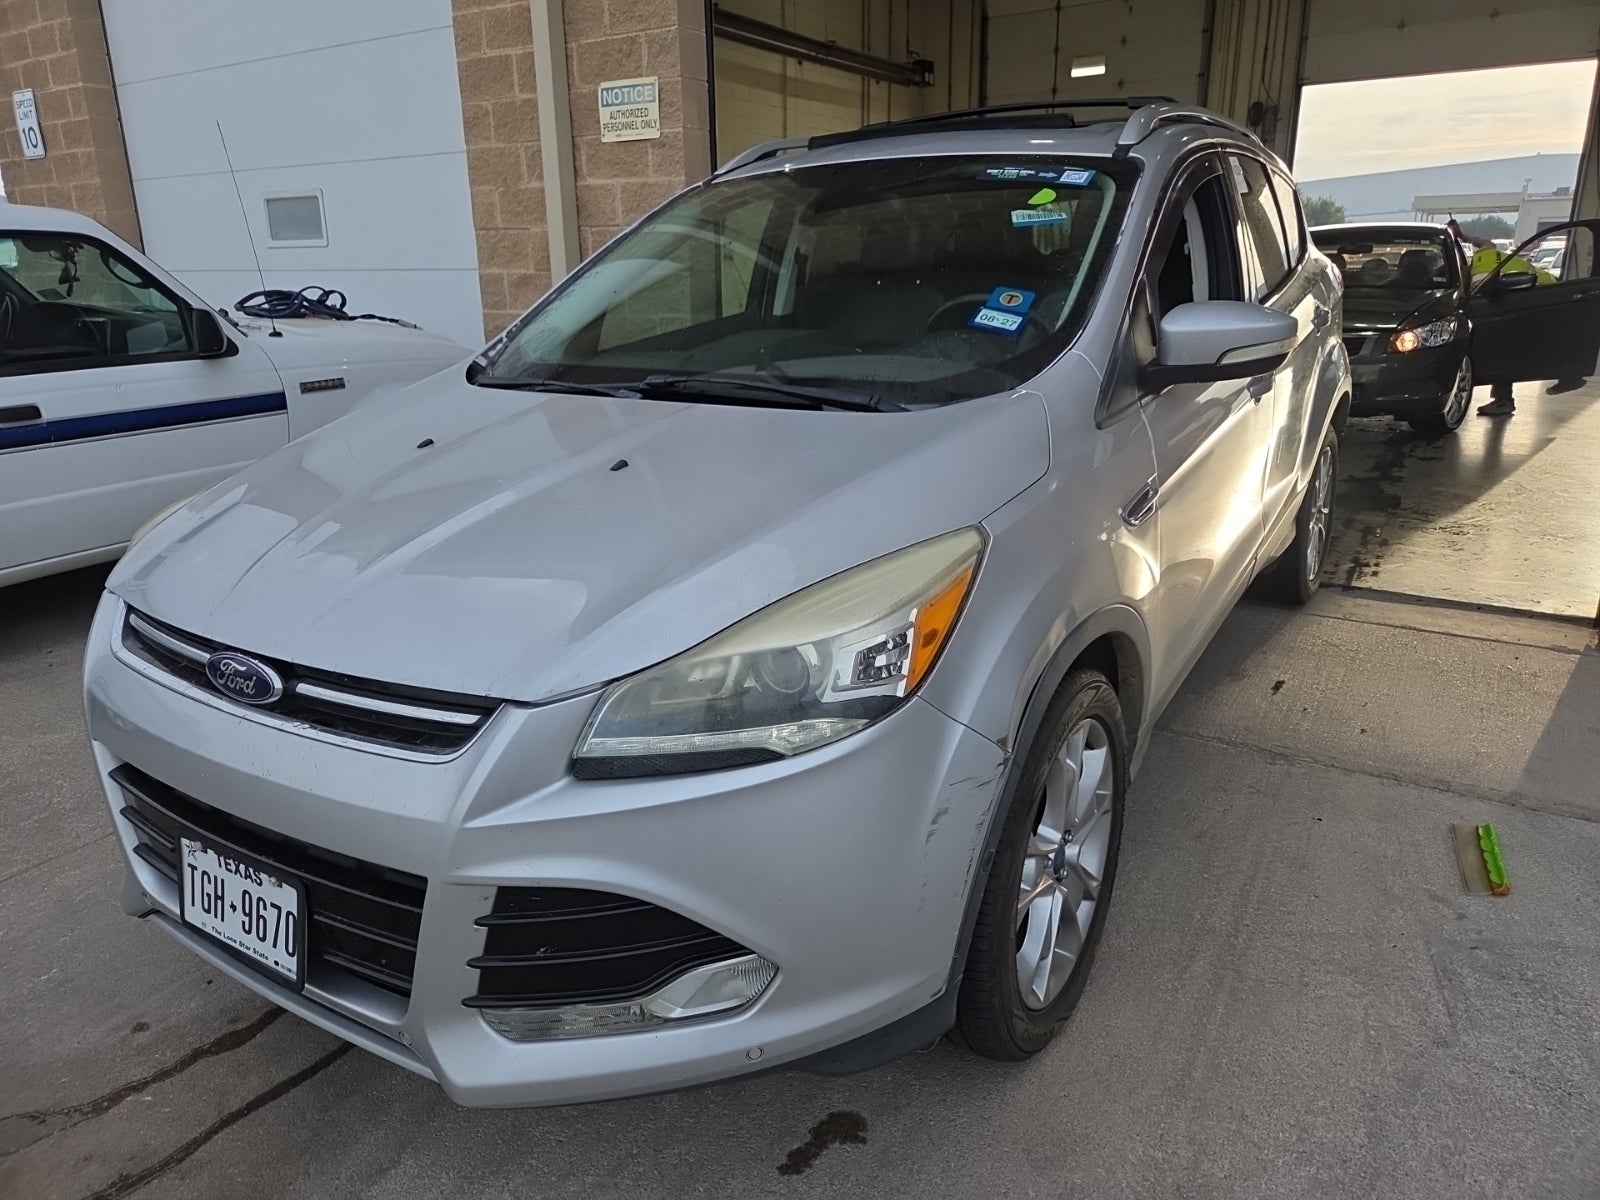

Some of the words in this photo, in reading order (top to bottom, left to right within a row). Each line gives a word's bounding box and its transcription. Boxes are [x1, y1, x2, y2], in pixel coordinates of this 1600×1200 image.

[602, 86, 654, 105] NOTICE
[16, 98, 33, 110] SPEED
[18, 110, 33, 121] LIMIT
[610, 107, 649, 120] AUTHORIZED
[603, 120, 639, 132] PERSONNEL
[640, 118, 658, 130] ONLY
[22, 126, 39, 150] 10
[1006, 293, 1020, 305] T
[217, 659, 257, 695] Ford
[217, 853, 264, 887] TEXAS
[211, 925, 222, 937] The
[223, 932, 238, 945] Lone
[238, 940, 252, 952] Star
[252, 947, 269, 961] State
